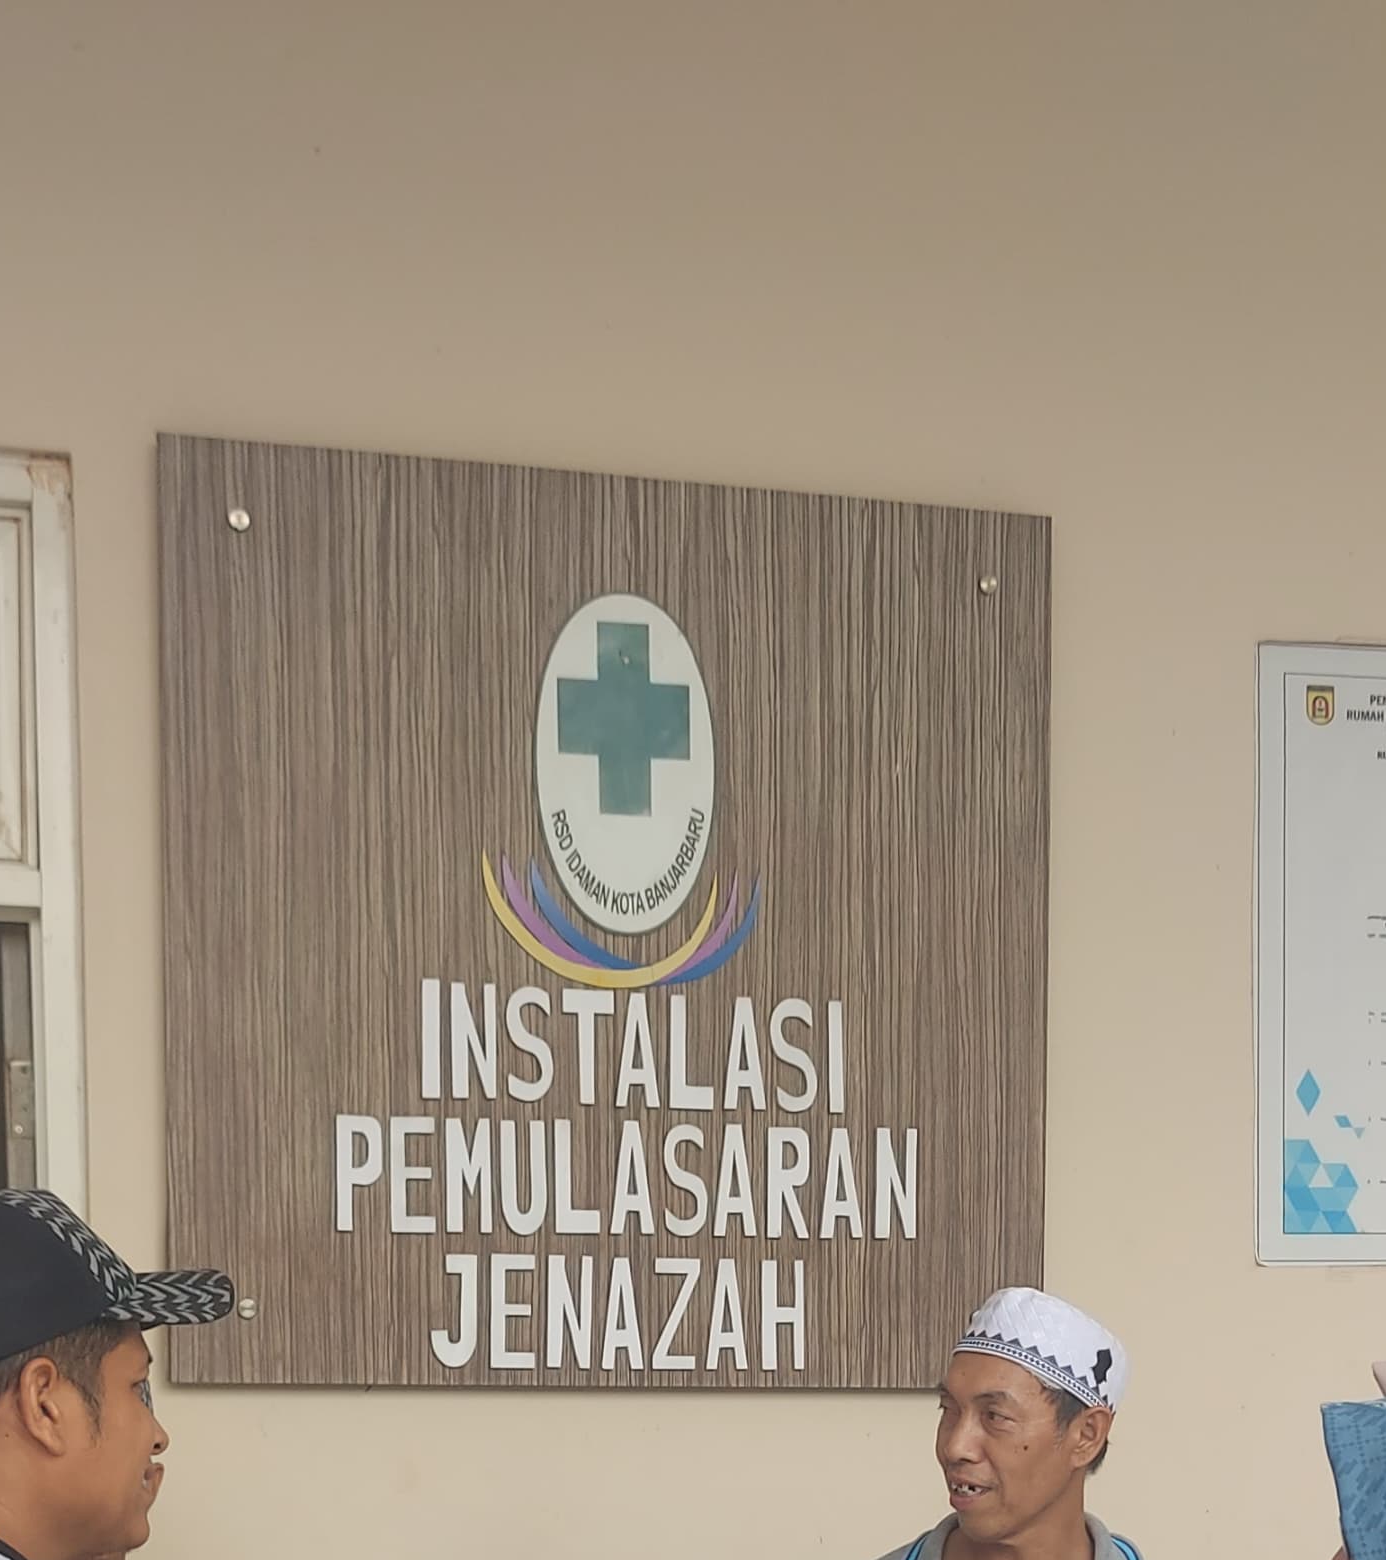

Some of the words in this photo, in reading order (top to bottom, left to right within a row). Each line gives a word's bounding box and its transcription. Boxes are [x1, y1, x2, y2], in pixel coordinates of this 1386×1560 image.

[1346, 709, 1384, 722] RUMAH
[551, 809, 573, 851] RSD
[565, 848, 611, 909] IDAMAN
[611, 892, 645, 916] KOTA
[644, 807, 705, 910] BANJARBARU
[421, 978, 845, 1114] INSTALASI
[335, 1113, 918, 1241] PEMULASARAN
[430, 1252, 806, 1372] JENAZAH
